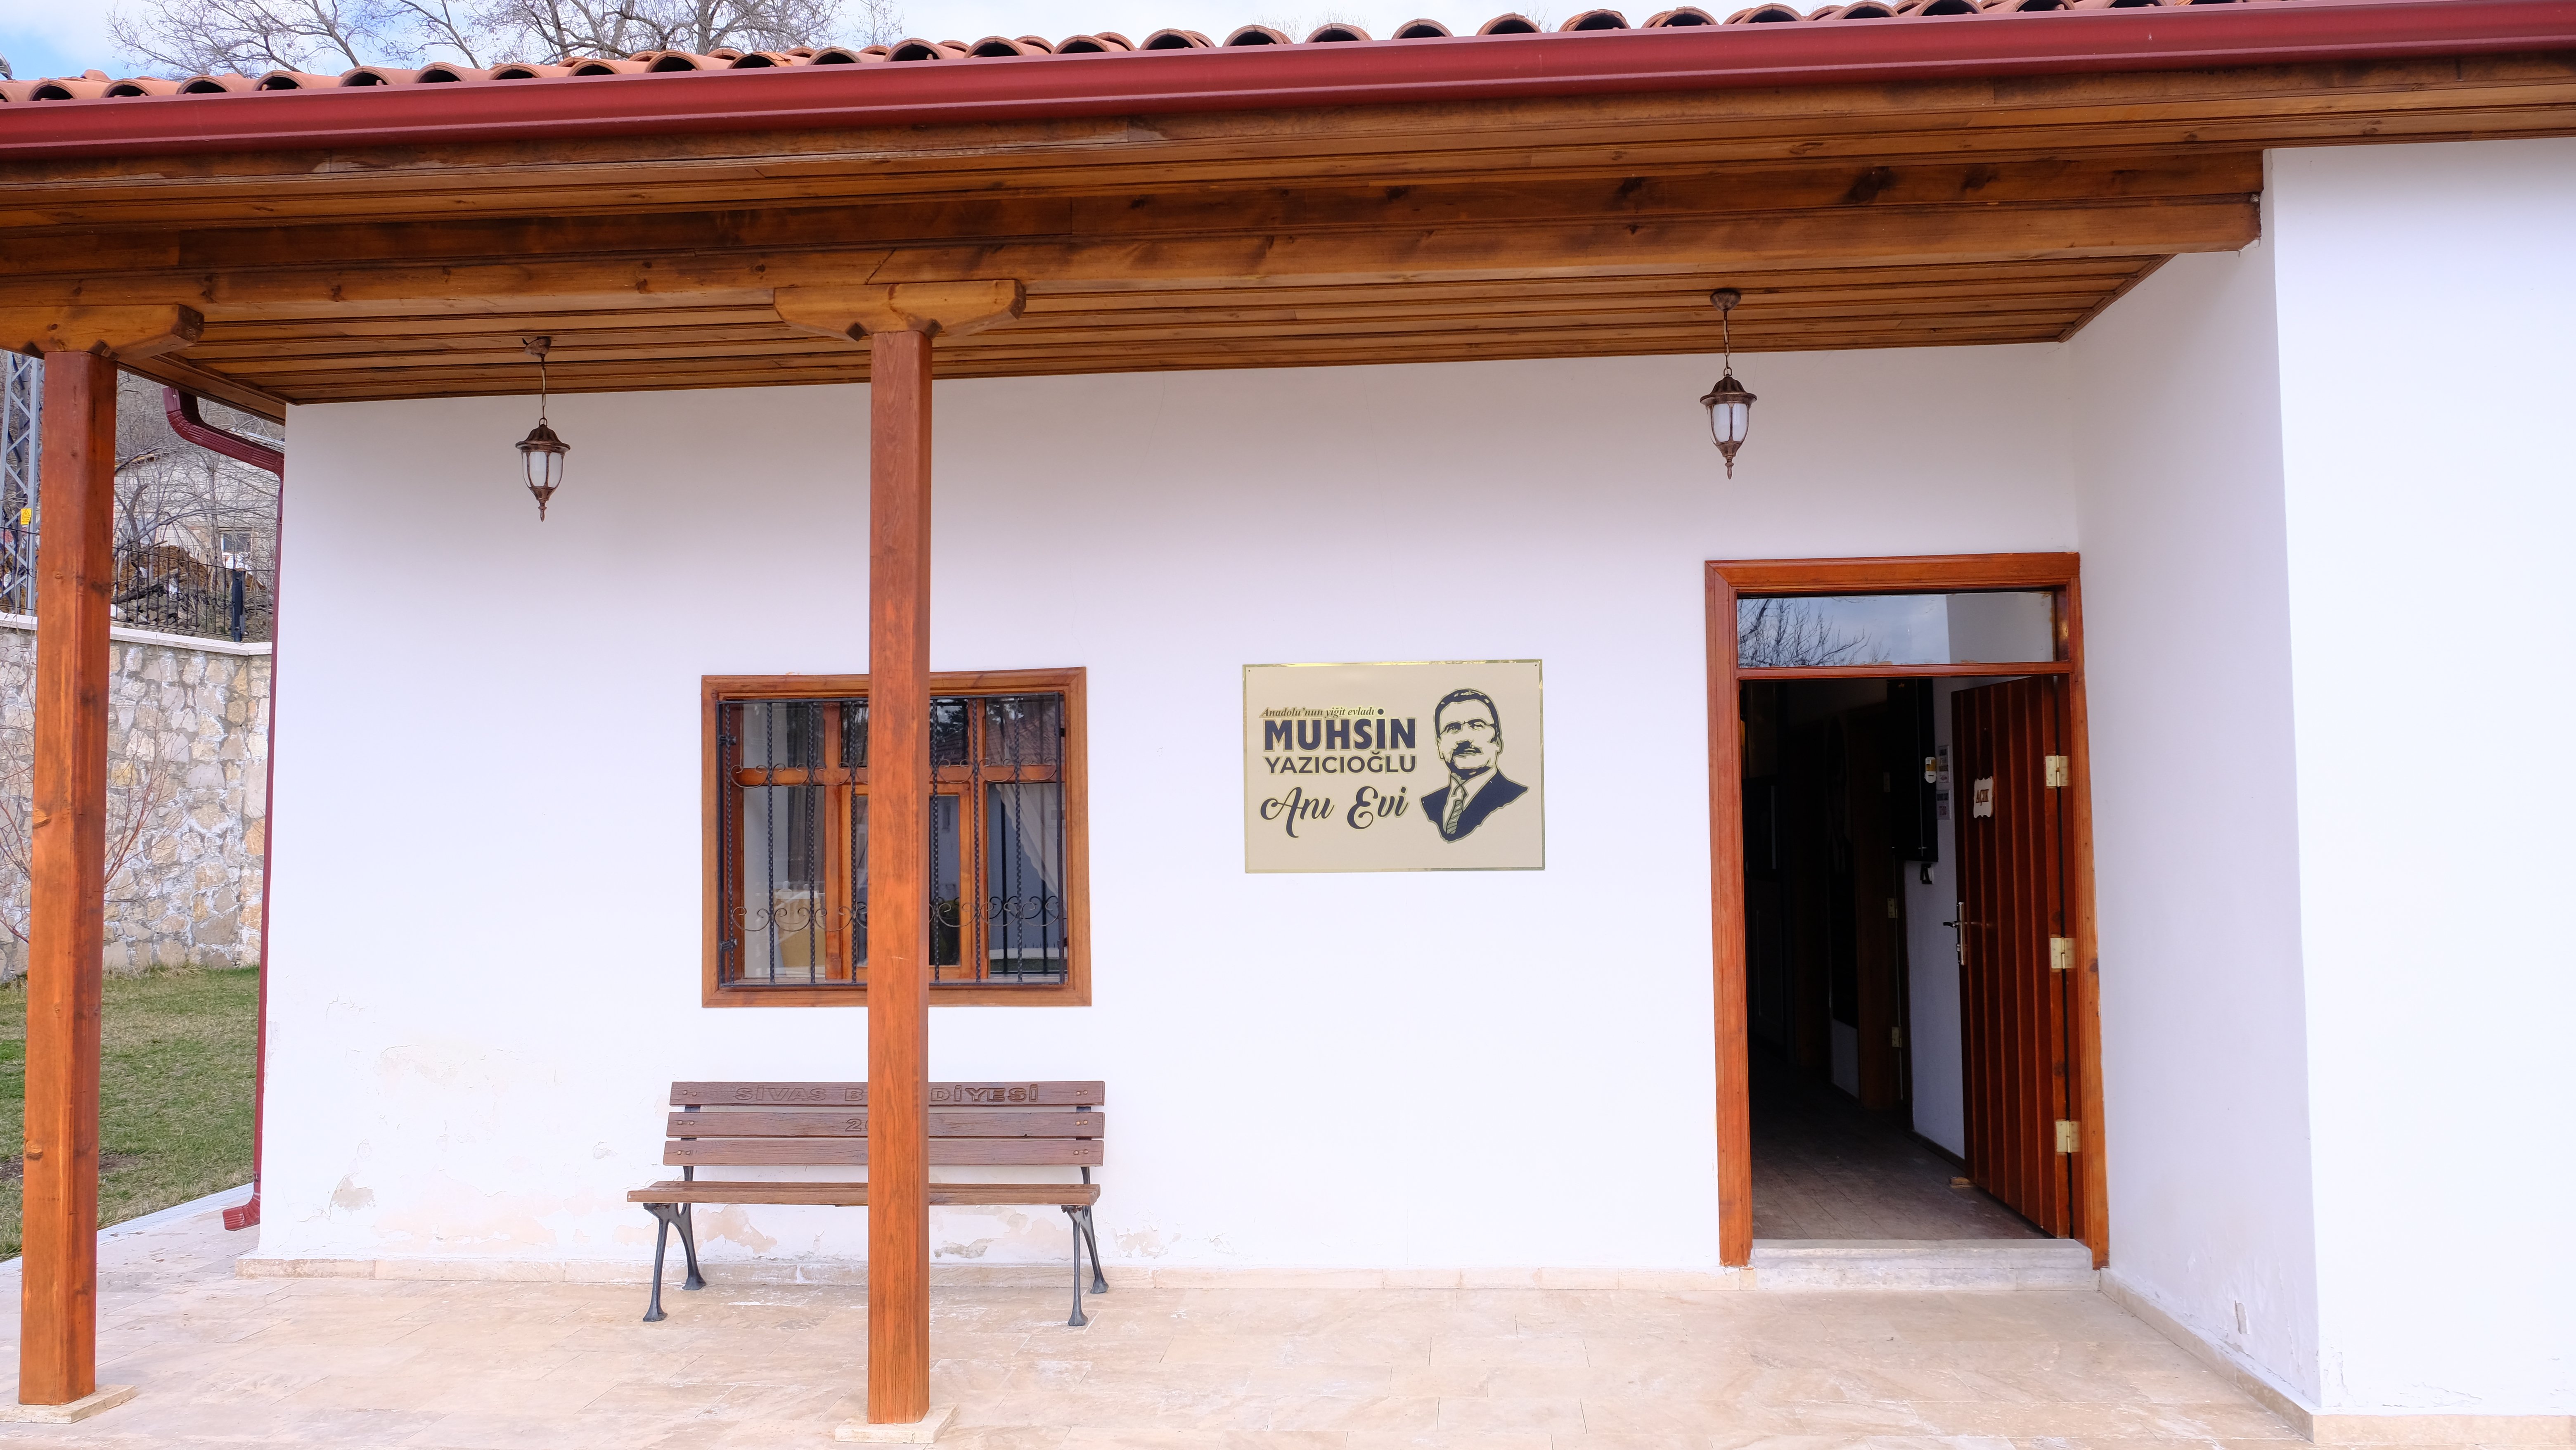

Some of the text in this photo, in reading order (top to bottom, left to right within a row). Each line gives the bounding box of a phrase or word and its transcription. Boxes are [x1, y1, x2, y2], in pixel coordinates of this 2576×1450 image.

[1325, 707, 1345, 718] yiğit
[1347, 707, 1375, 716] evladı
[1264, 708, 1416, 750] MUHSİN
[1264, 751, 1416, 774] YAZICIOĞLU
[1260, 786, 1409, 838] Anı Evi
[734, 1084, 1038, 1102] SİVAS BDİYESİ
